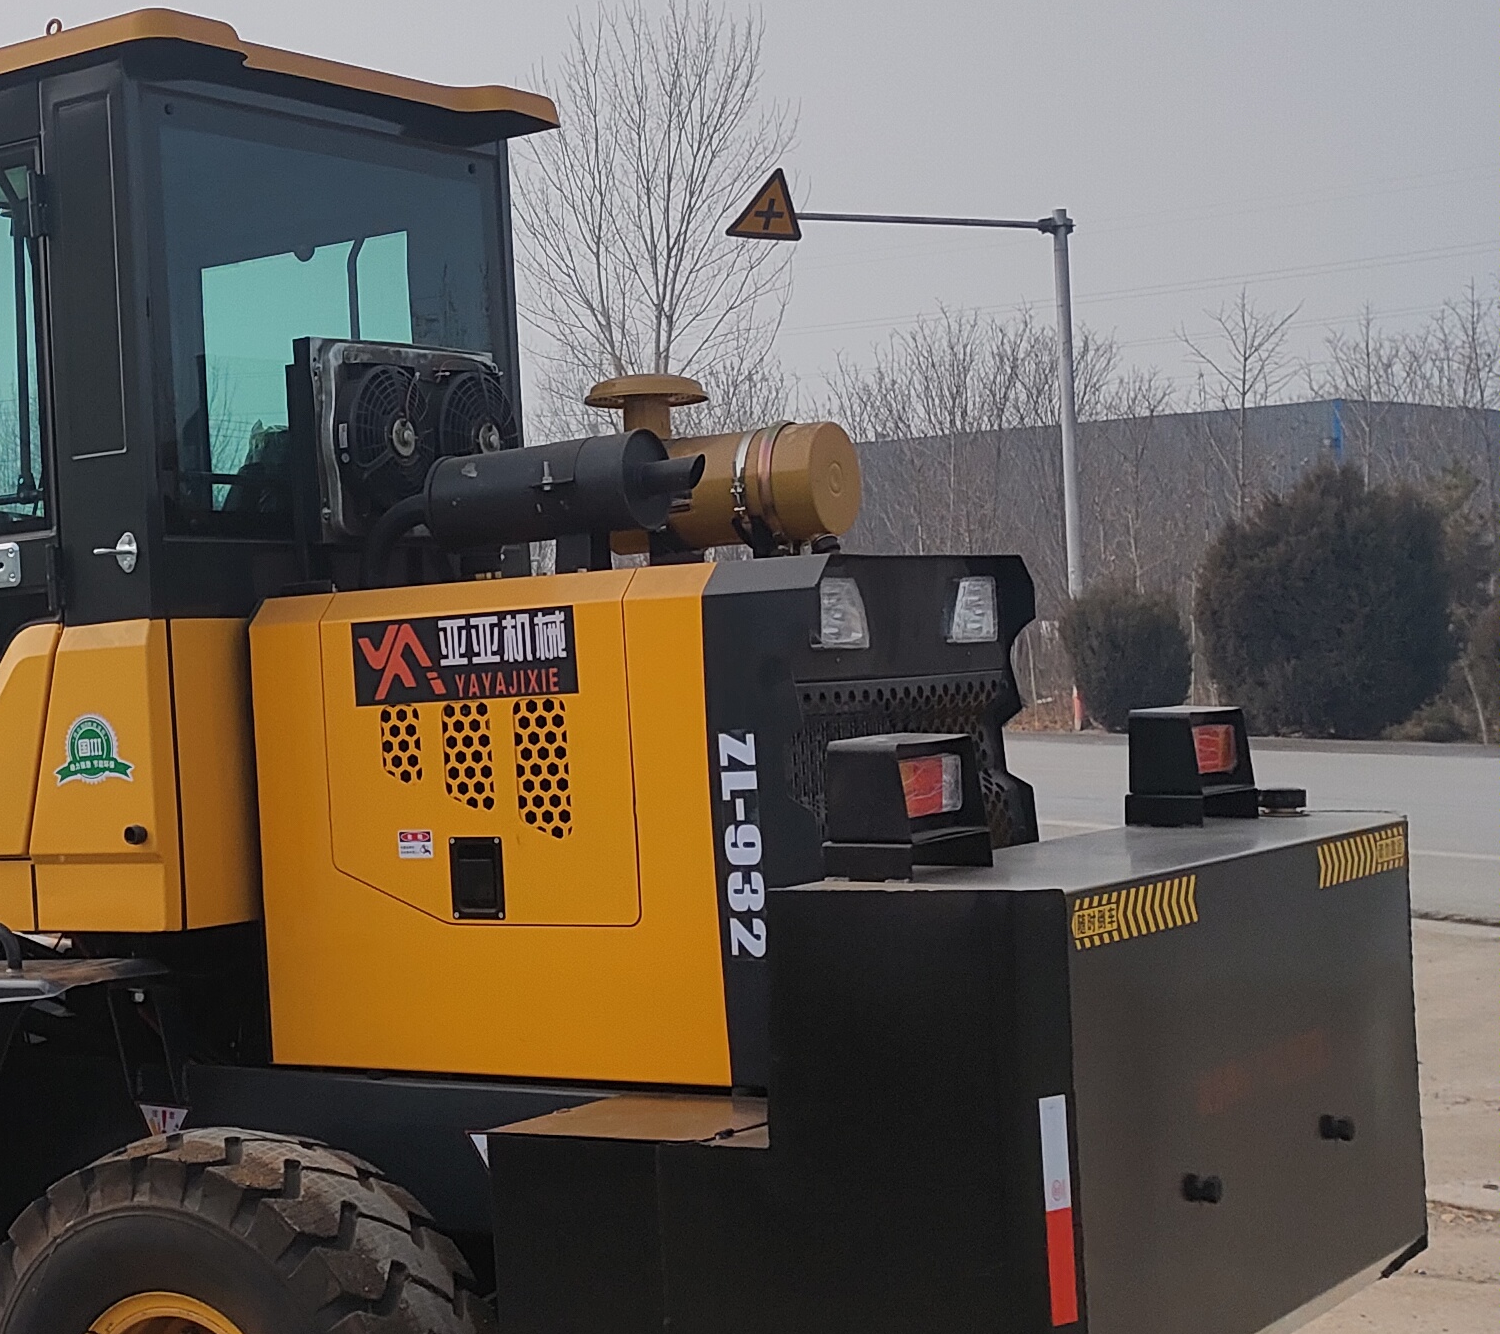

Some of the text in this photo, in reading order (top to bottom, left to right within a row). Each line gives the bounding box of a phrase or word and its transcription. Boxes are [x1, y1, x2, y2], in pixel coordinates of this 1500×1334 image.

[437, 610, 567, 666] 亚亚机械
[455, 668, 559, 698] YAYAJIXIE
[718, 733, 767, 958] ZL-932
